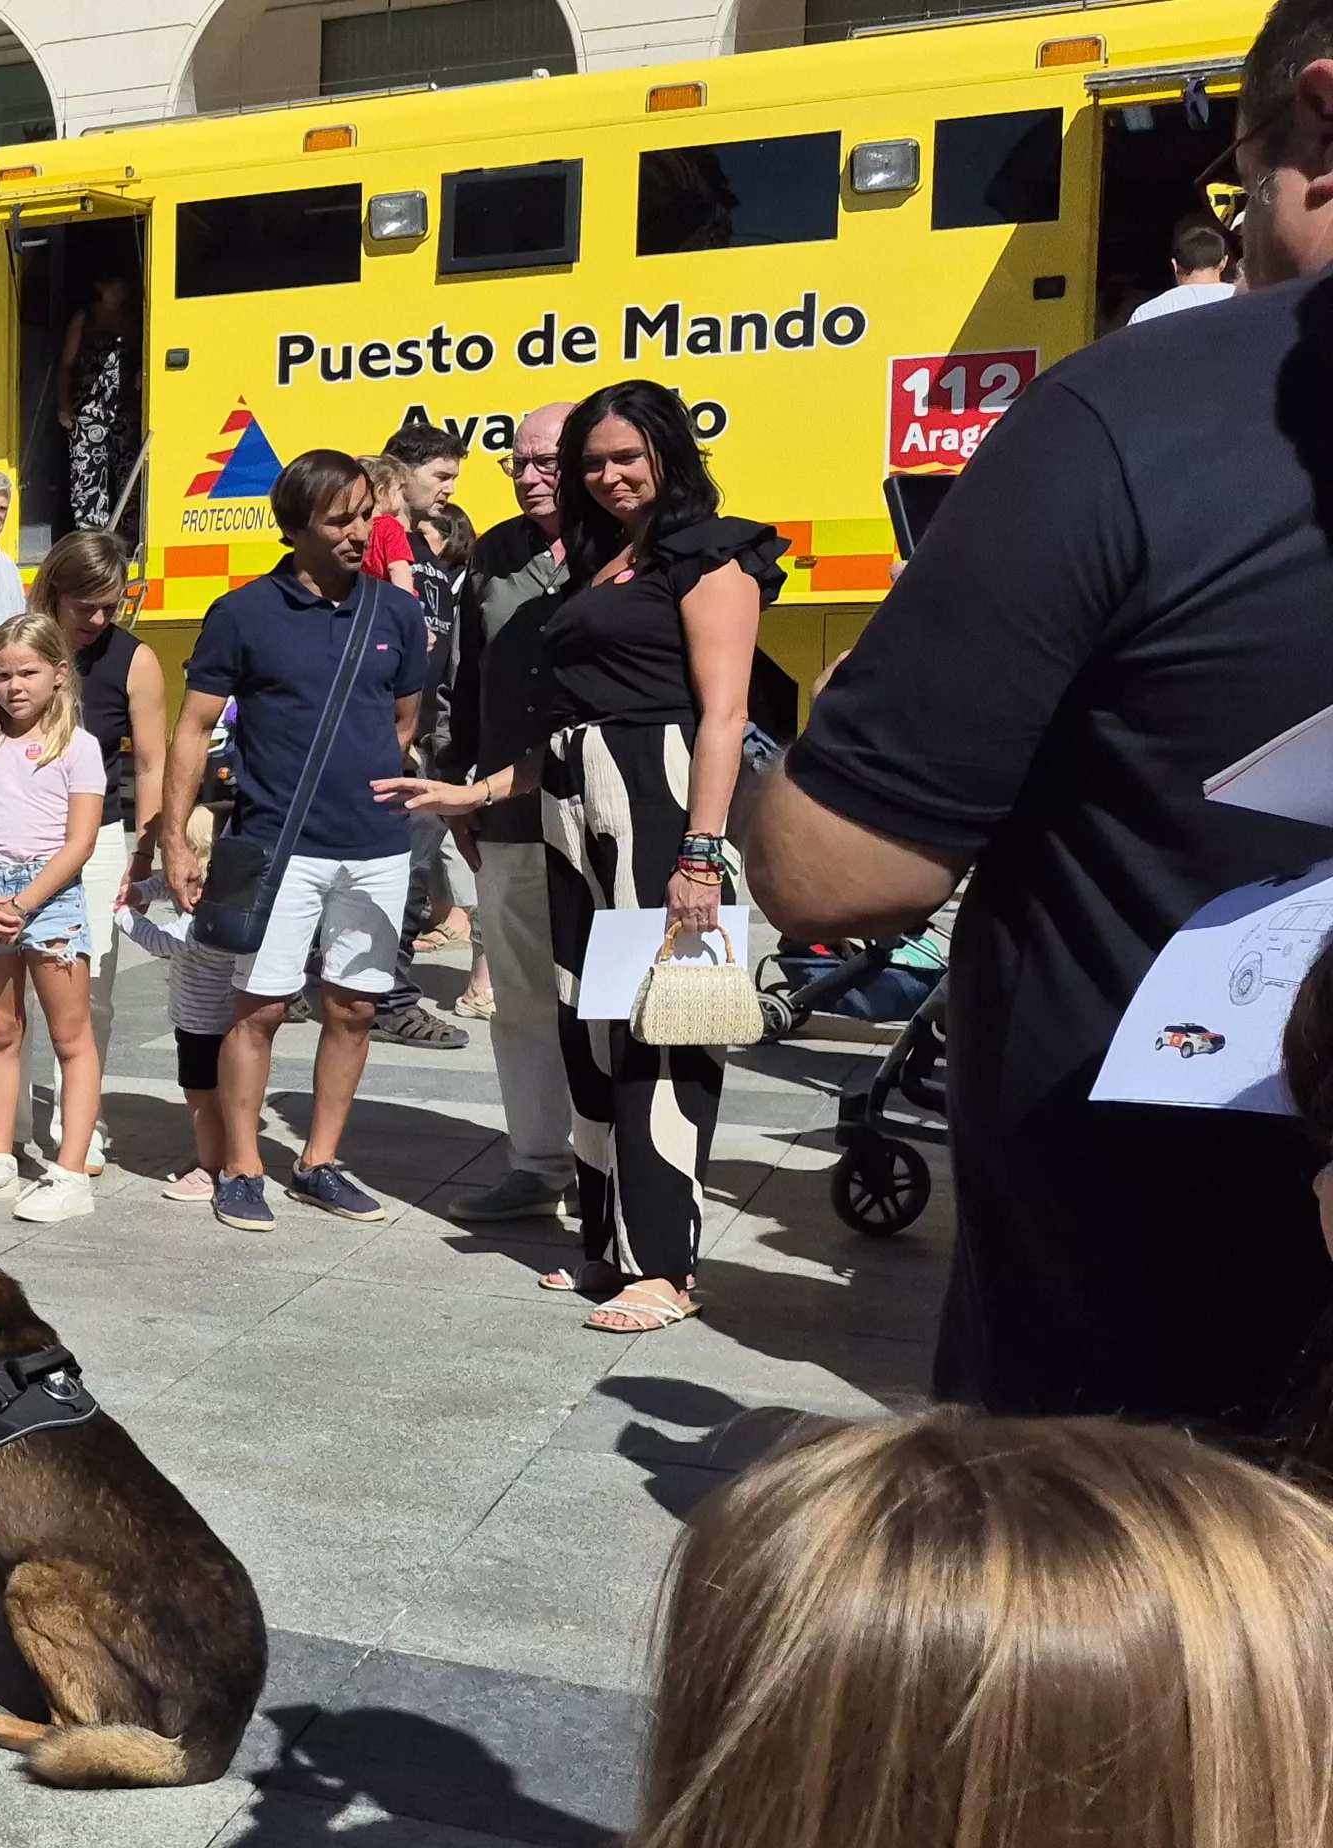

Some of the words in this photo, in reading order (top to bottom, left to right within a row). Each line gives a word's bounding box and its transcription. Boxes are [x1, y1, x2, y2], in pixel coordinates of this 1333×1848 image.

[277, 325, 494, 386] Puesto
[517, 313, 596, 367] de
[623, 292, 866, 361] Mando
[902, 362, 1021, 418] 112
[899, 418, 1000, 459] Arag
[180, 507, 266, 533] PROTECCION
